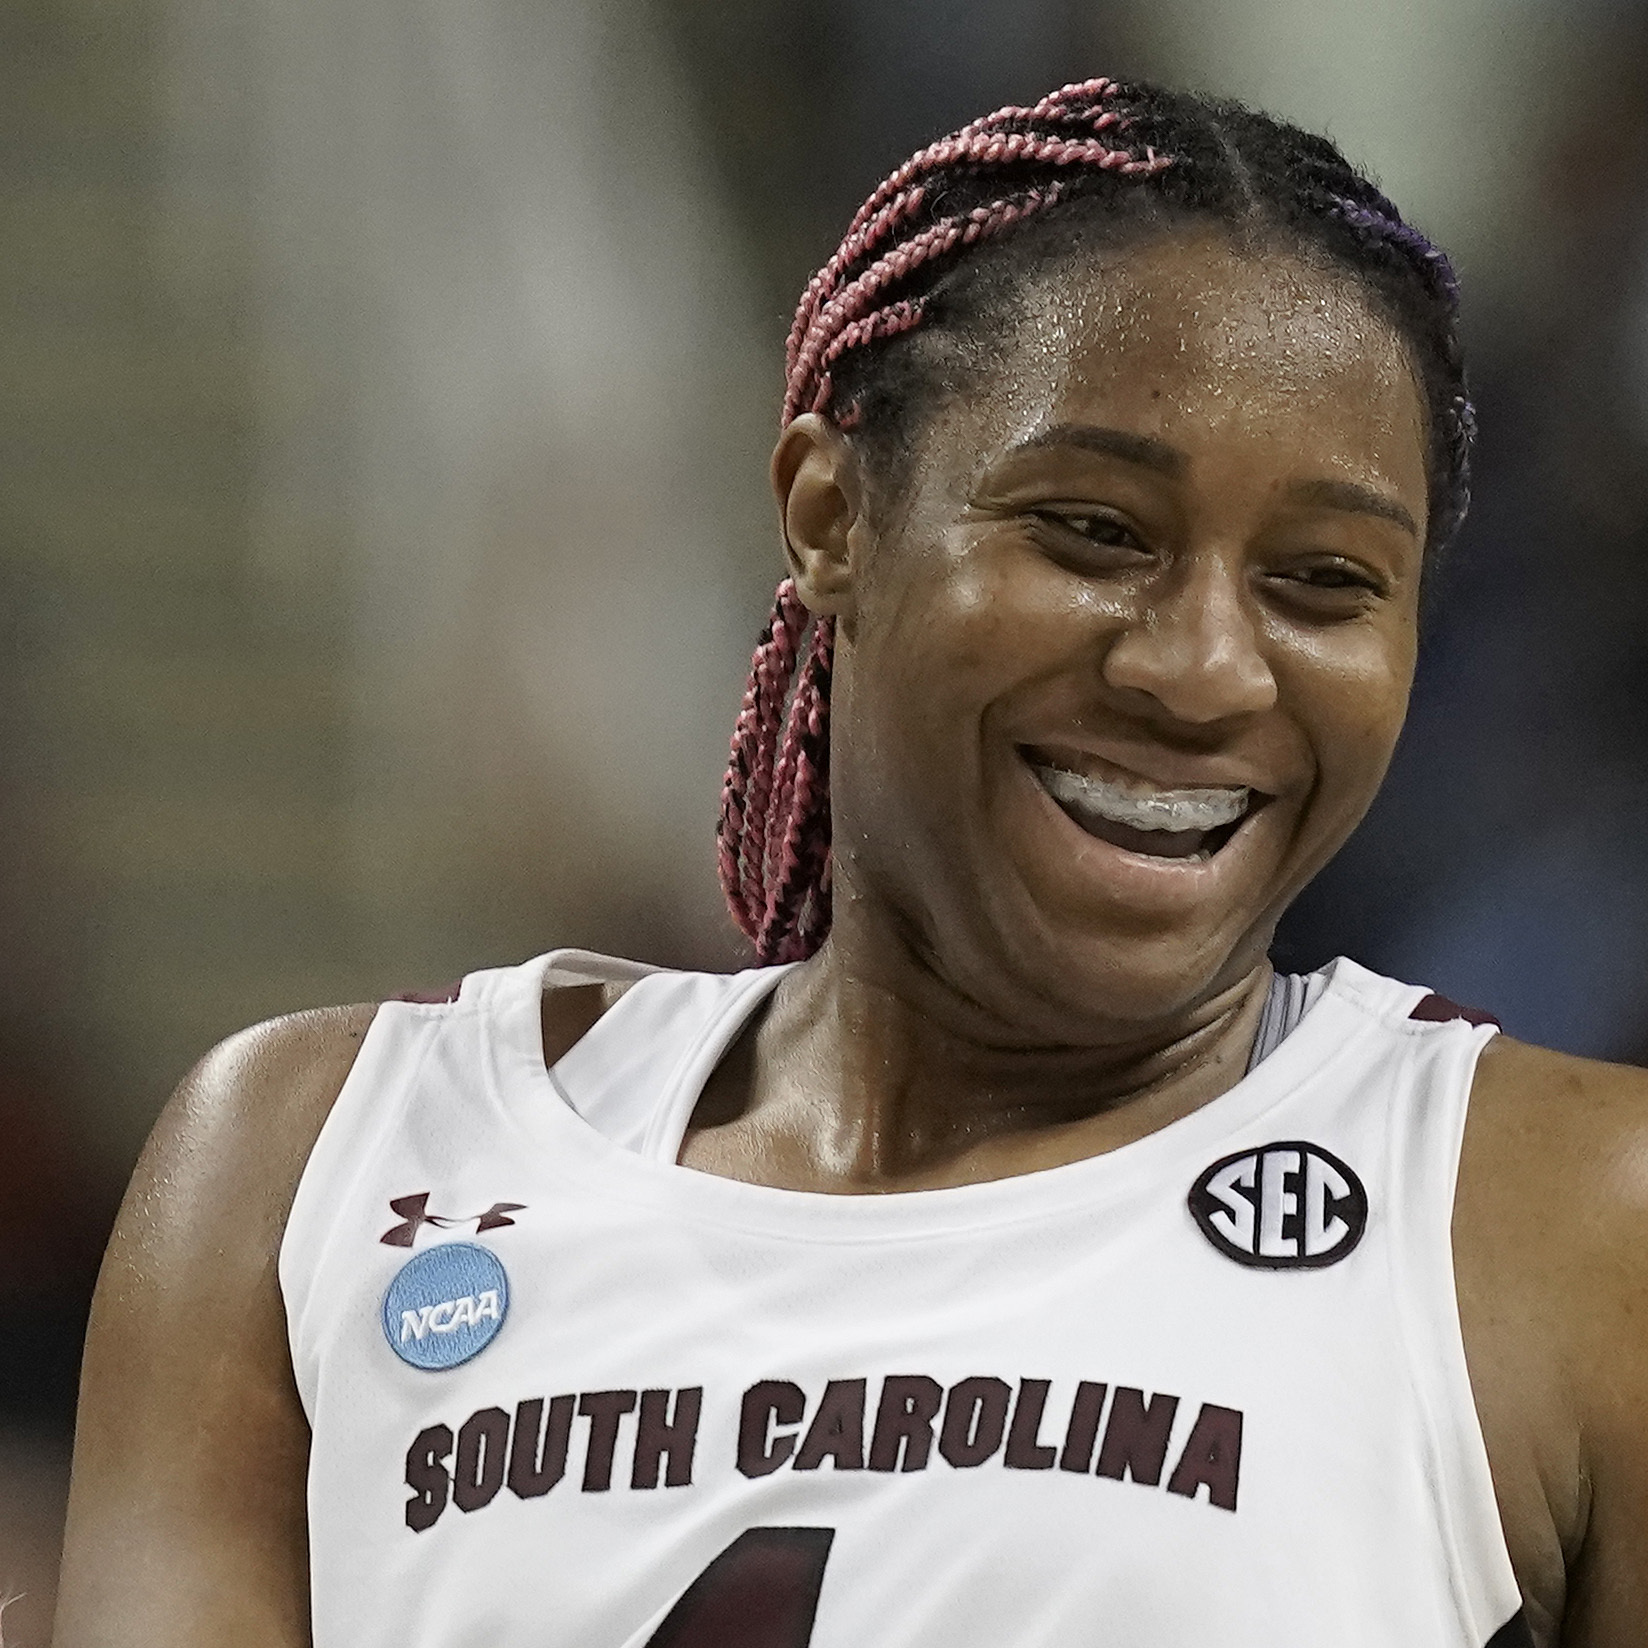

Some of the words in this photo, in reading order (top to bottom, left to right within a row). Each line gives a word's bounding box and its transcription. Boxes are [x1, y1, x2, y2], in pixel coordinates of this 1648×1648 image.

[1206, 1150, 1351, 1257] SEC
[400, 1289, 499, 1343] NCAA
[403, 1385, 703, 1534] SOUTH
[734, 1374, 1244, 1513] CAROLINA
